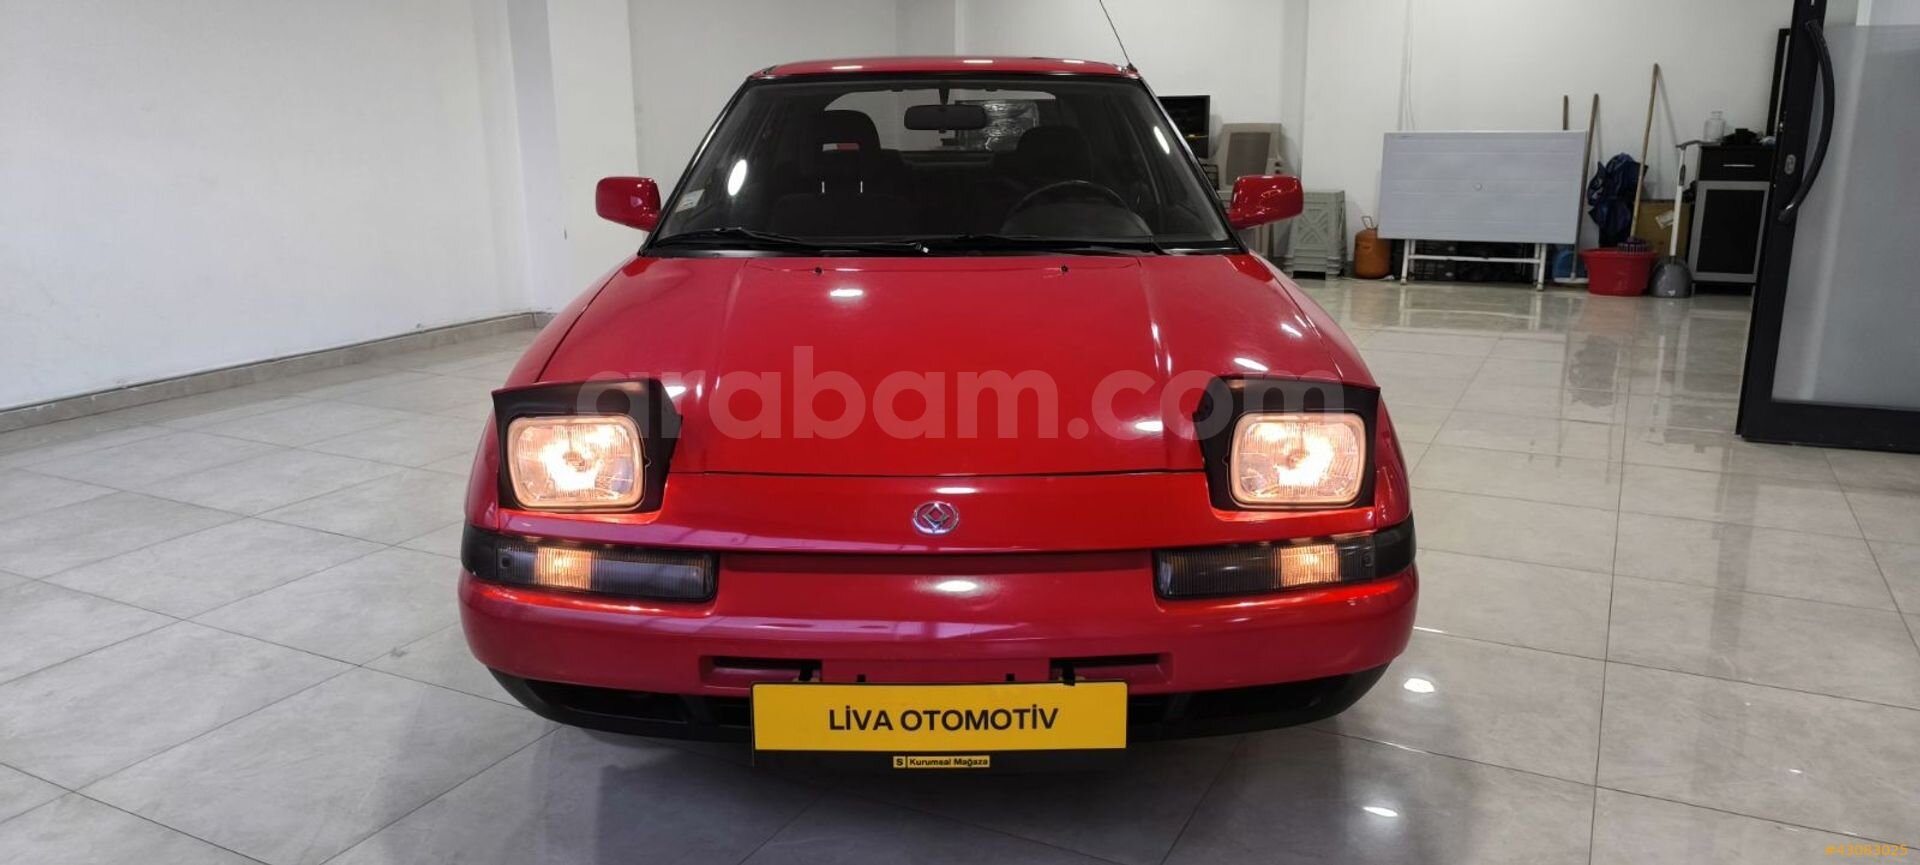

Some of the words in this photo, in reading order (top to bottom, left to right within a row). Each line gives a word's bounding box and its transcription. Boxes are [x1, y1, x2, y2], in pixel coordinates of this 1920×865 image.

[829, 705, 894, 731] LİVA
[900, 704, 1059, 731] OTOMOTİV
[909, 758, 952, 767] Kurumsal
[954, 757, 988, 768] Mağaza
